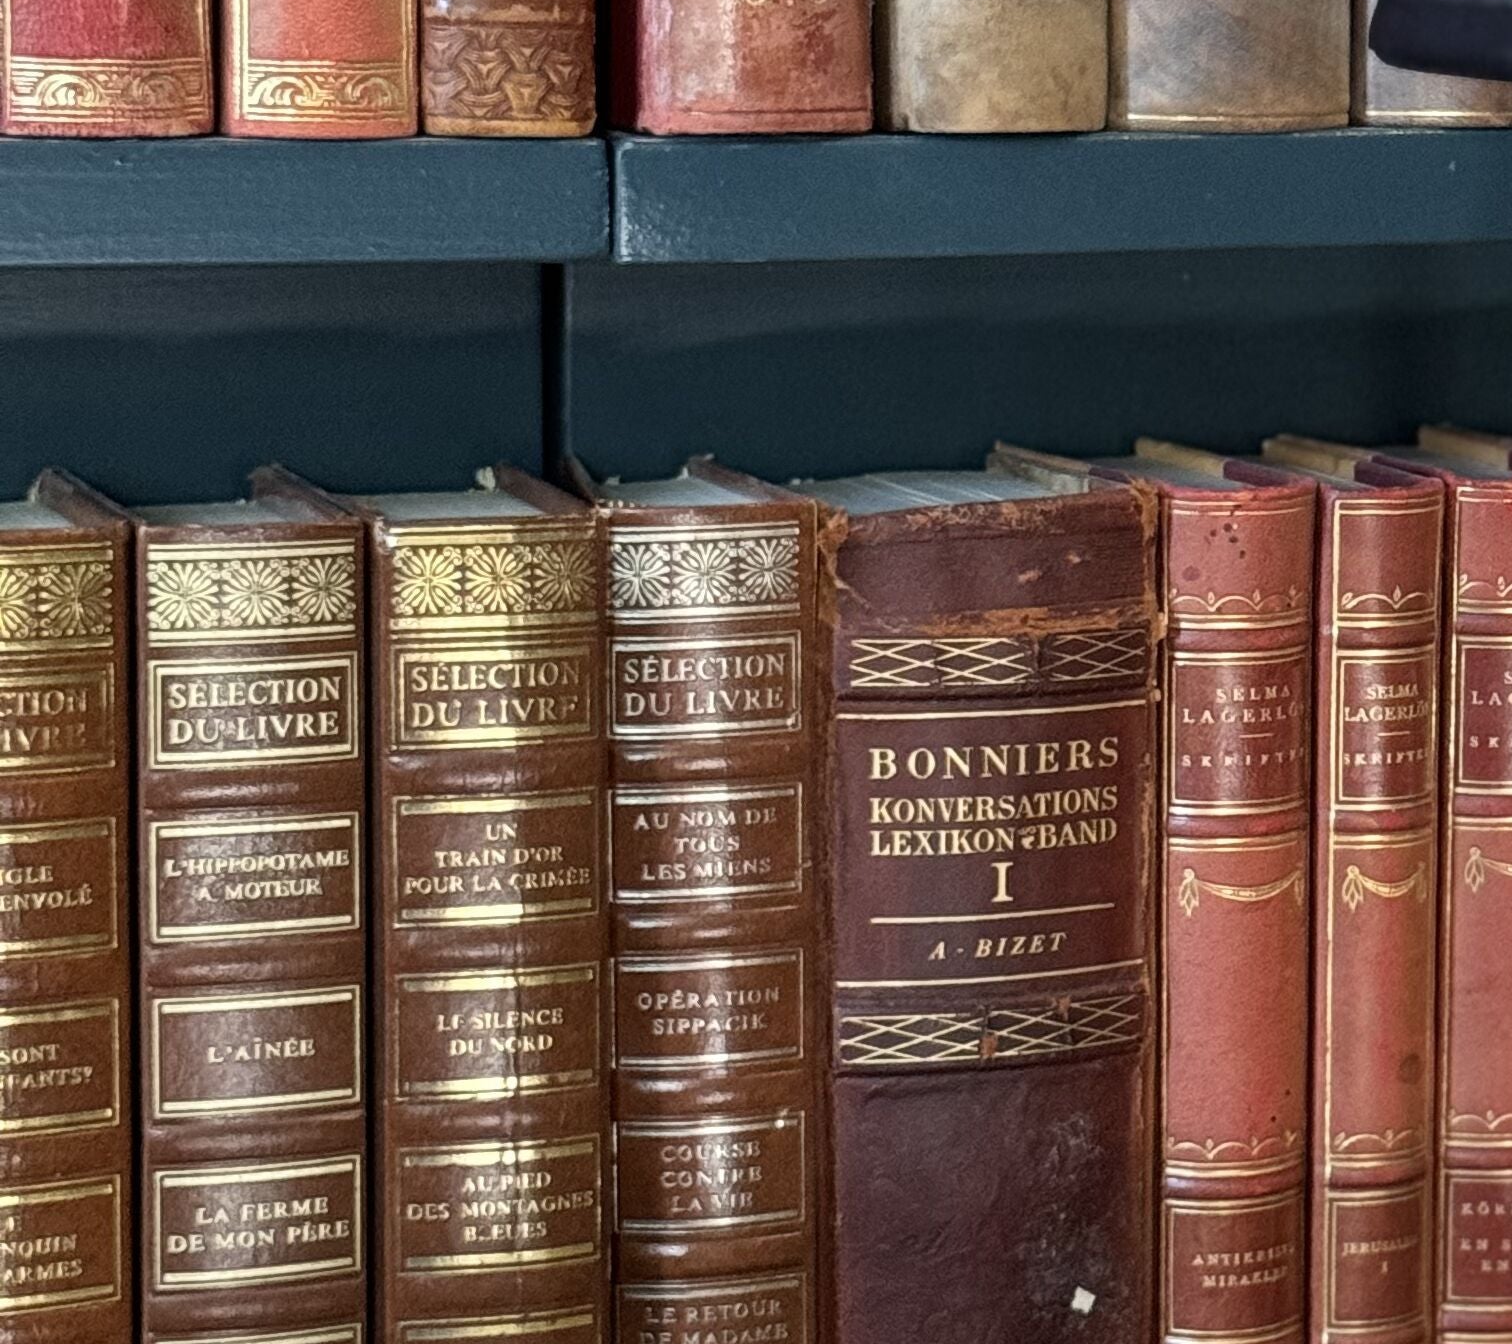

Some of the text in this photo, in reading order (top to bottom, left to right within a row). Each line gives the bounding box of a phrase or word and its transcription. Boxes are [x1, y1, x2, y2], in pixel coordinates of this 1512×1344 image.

[411, 660, 580, 693] SÉLECTION
[623, 652, 786, 684] SÉLECTION
[167, 675, 344, 710] SÉLECTION
[624, 685, 785, 718] DU LIVRE
[1215, 684, 1292, 705] SELMA
[1365, 683, 1420, 701] SELMA
[411, 694, 579, 728] DU LIVRE
[167, 711, 340, 746] DU LIVRE
[868, 737, 1119, 781] BONNIERS
[868, 785, 1119, 825] KONVERSATIONS
[485, 822, 518, 842] UN
[633, 806, 778, 832] AU NOM DE
[673, 834, 741, 855] TOUS
[869, 816, 1118, 857] LEXIKON BAND
[164, 849, 350, 878] L'HIPPOPOTAME
[433, 845, 564, 869] TRAIN D'OR
[640, 857, 772, 882] LES MIENS
[224, 877, 324, 902] MOTEUR
[404, 867, 592, 896] POUR LA CRIMÉE
[991, 861, 1014, 904] I
[928, 931, 1069, 962] A BIZET
[637, 986, 781, 1011] OPÉRATION
[436, 1006, 565, 1033] LE SILENCE
[652, 1012, 769, 1036] SIPPACIK
[206, 1036, 317, 1064] L'AÎNÉE
[450, 1033, 554, 1057] DU NORD
[660, 1140, 761, 1163] COURSE
[461, 1170, 553, 1193] AU PIED
[660, 1166, 763, 1189] CONTRE
[195, 1196, 330, 1226] LA FERME
[406, 1189, 594, 1222] DES MONTAGNES
[670, 1191, 753, 1214] LA VIE
[166, 1233, 206, 1255] DE
[214, 1228, 275, 1250] MON
[463, 1221, 548, 1243] BLEUES
[645, 1298, 783, 1325] LE RETOUR
